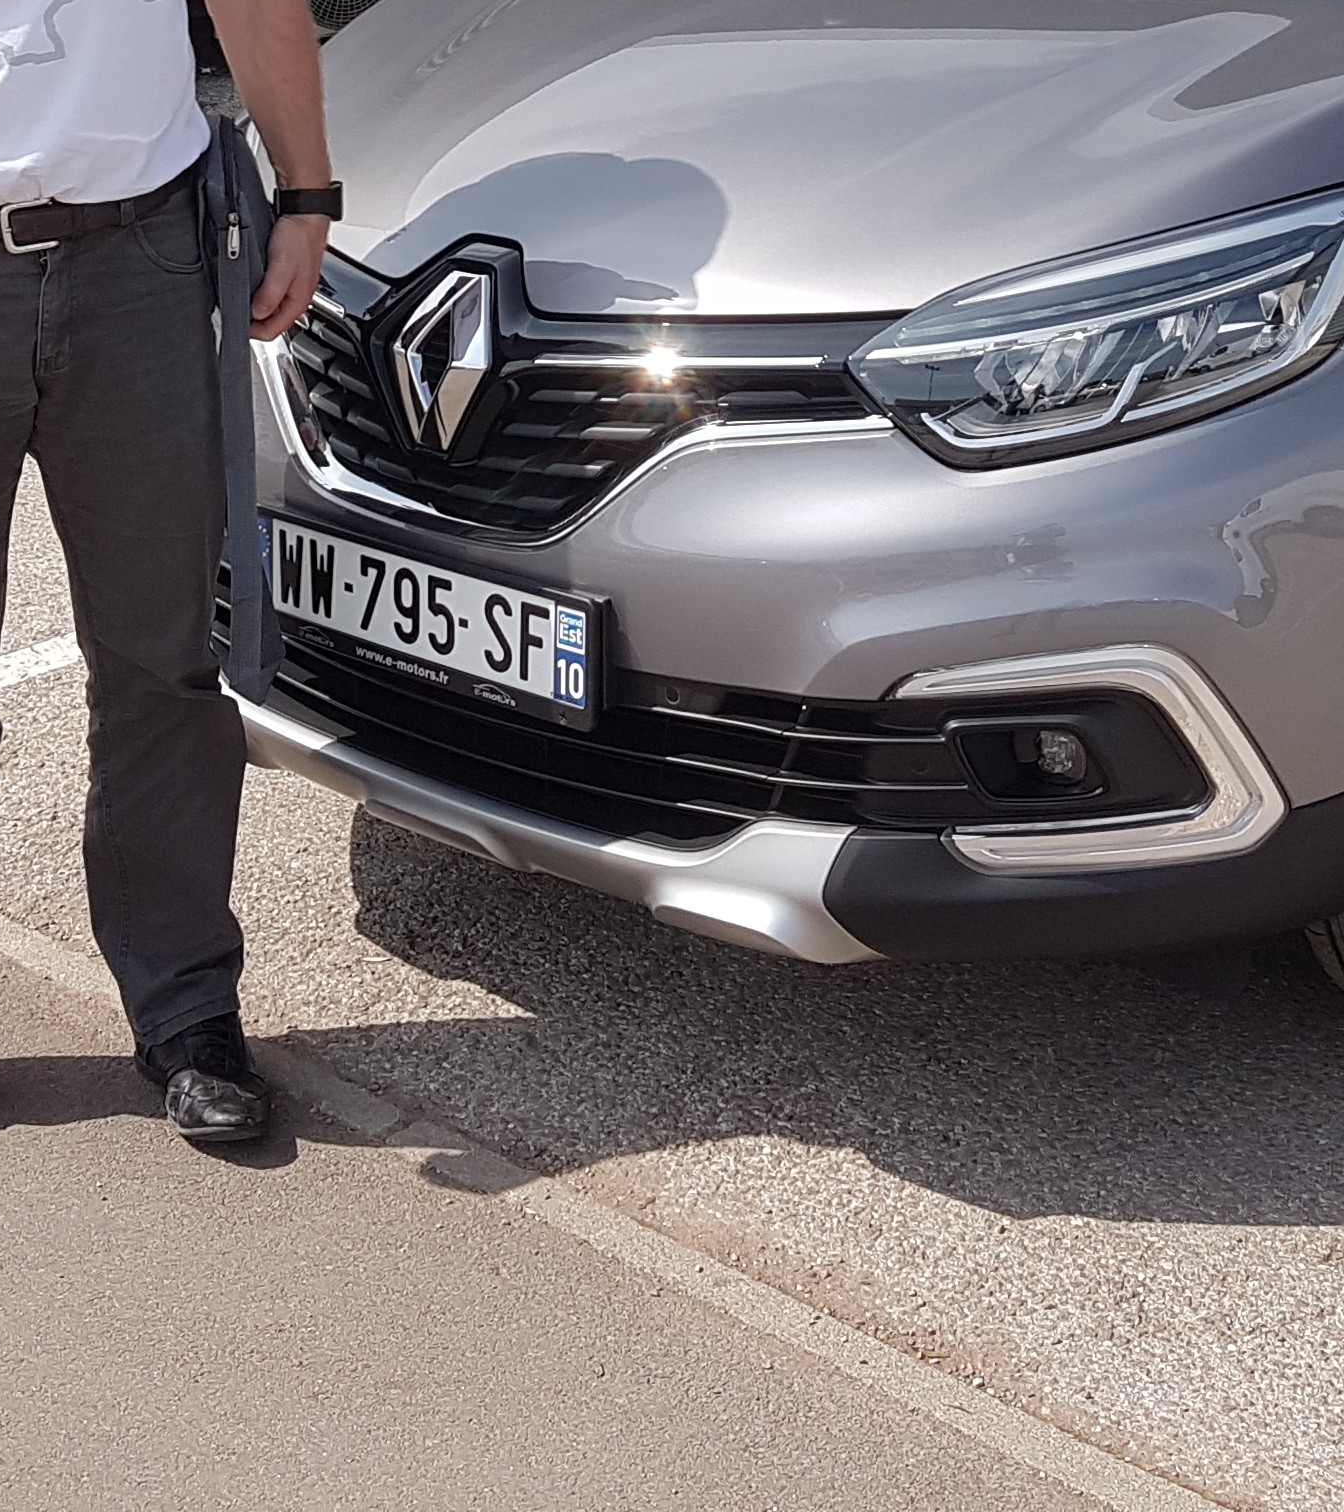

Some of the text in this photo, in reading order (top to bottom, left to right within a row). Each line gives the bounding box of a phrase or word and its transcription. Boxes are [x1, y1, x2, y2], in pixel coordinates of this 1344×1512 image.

[278, 528, 551, 682] WW-795-SF
[559, 613, 584, 628] Grand
[559, 623, 583, 646] Est
[355, 645, 450, 685] www.e-motors.fr
[557, 658, 585, 700] 10
